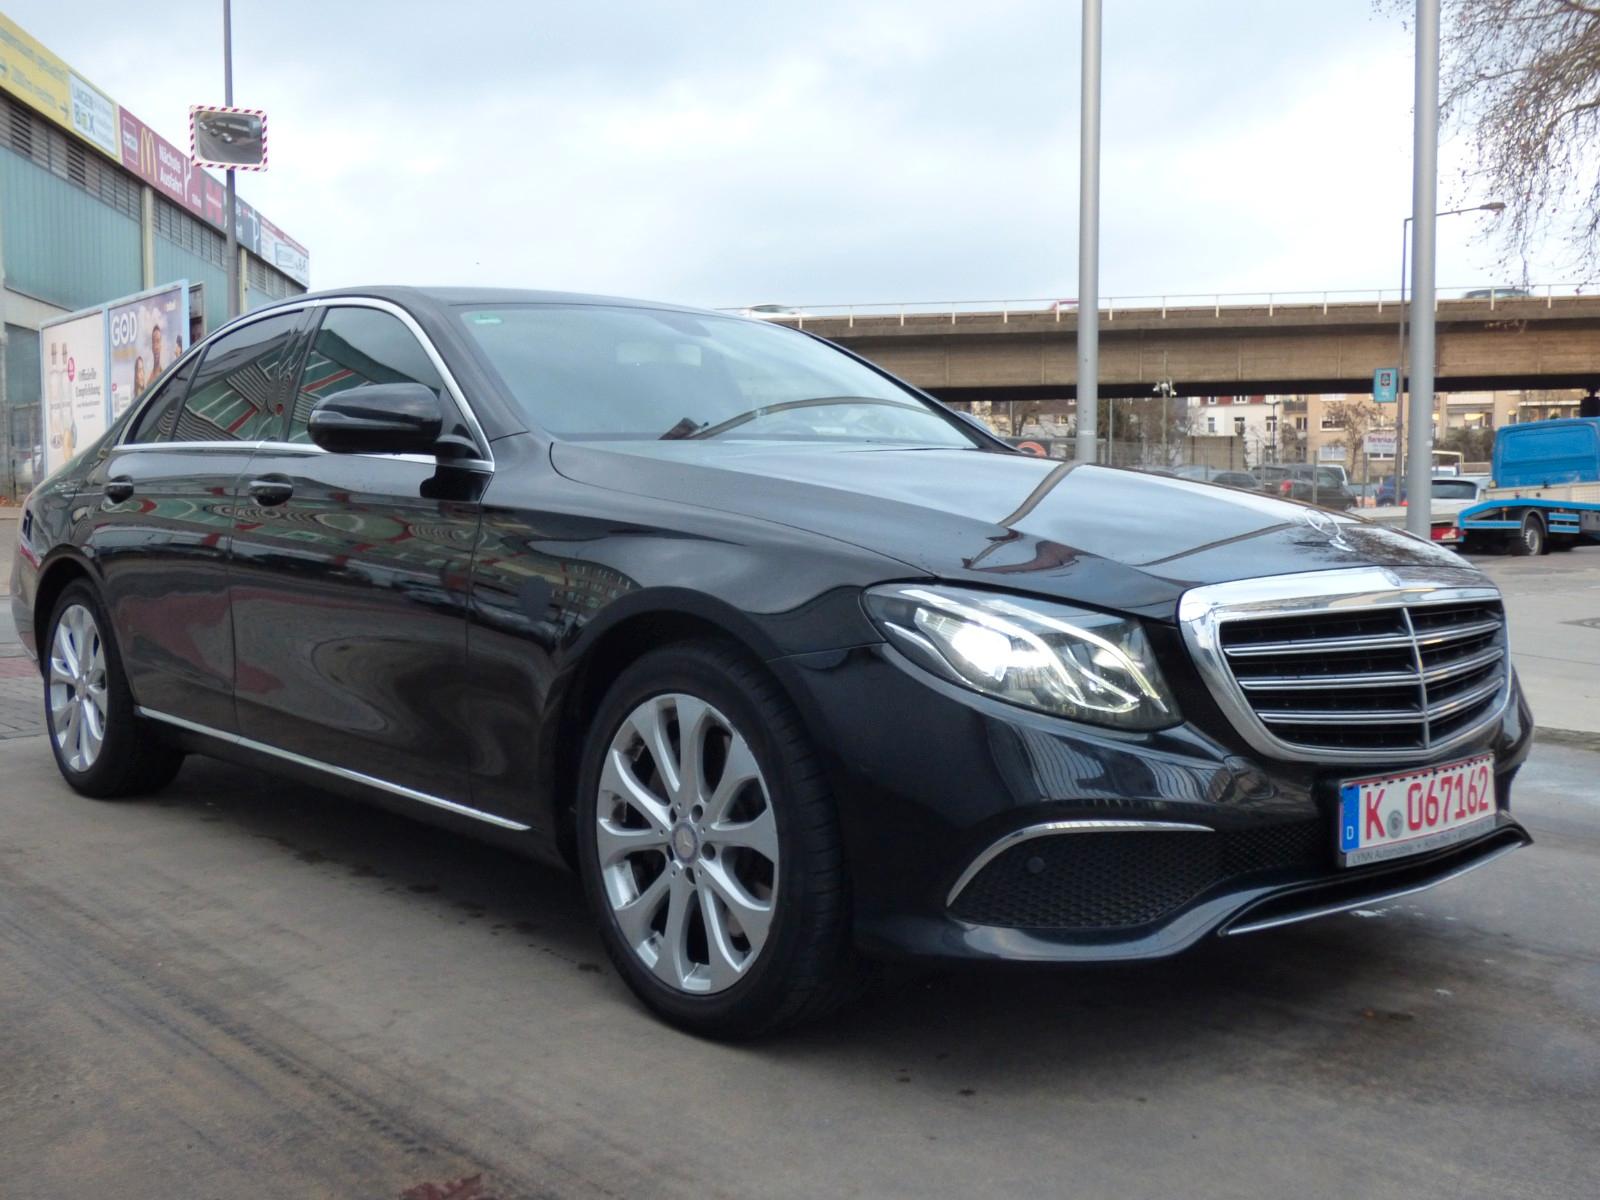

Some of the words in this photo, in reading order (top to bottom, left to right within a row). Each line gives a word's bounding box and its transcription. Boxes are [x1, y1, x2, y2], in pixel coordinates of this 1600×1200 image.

[1365, 788, 1386, 840] K
[1407, 766, 1489, 831] 067162
[1346, 825, 1354, 840] D
